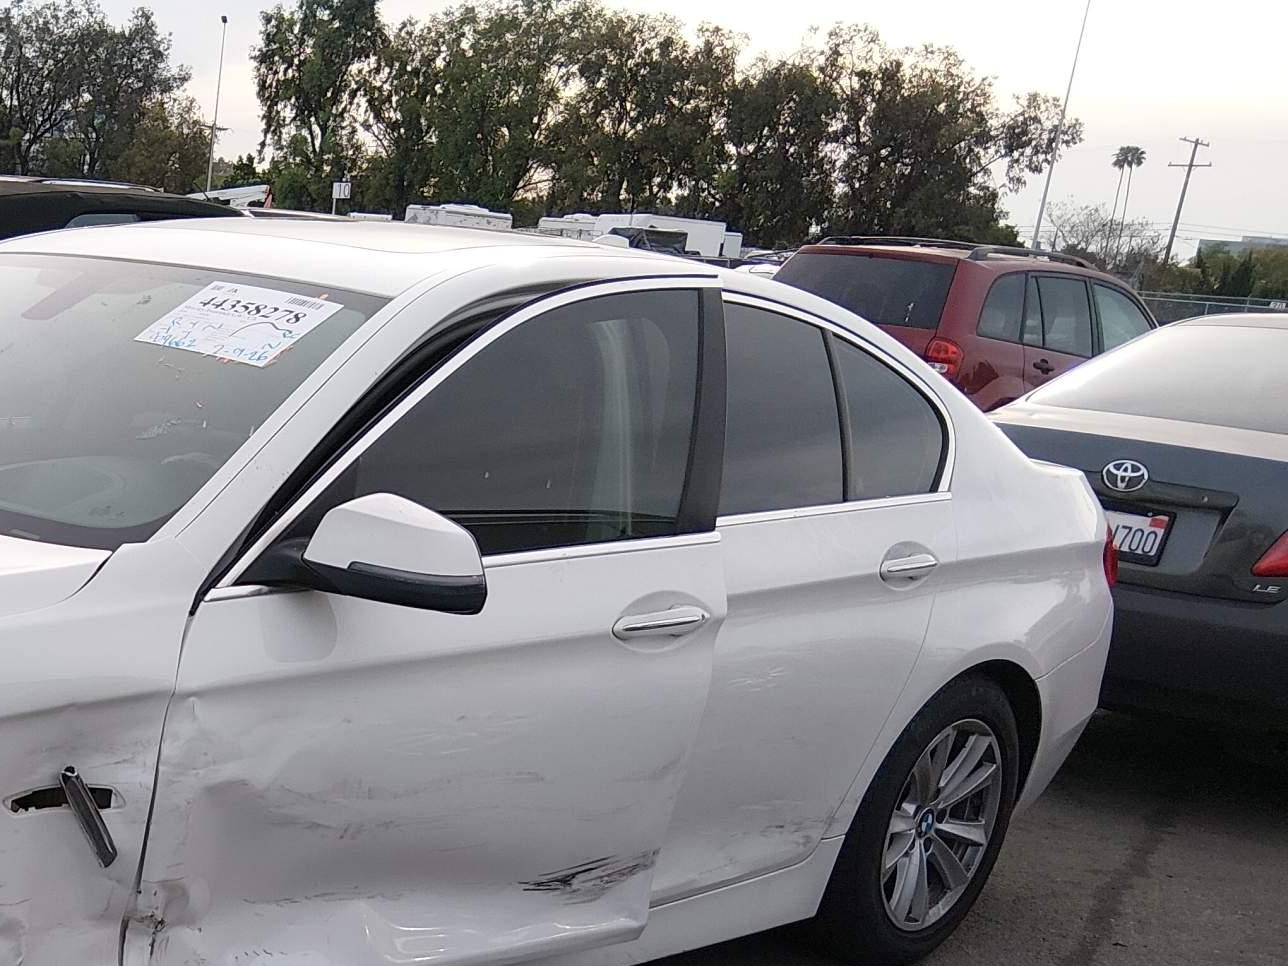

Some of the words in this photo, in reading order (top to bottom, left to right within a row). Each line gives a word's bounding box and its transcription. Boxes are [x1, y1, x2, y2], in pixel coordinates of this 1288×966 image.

[338, 183, 350, 198] 10
[199, 296, 308, 324] 44358278
[1252, 584, 1281, 594] LE
